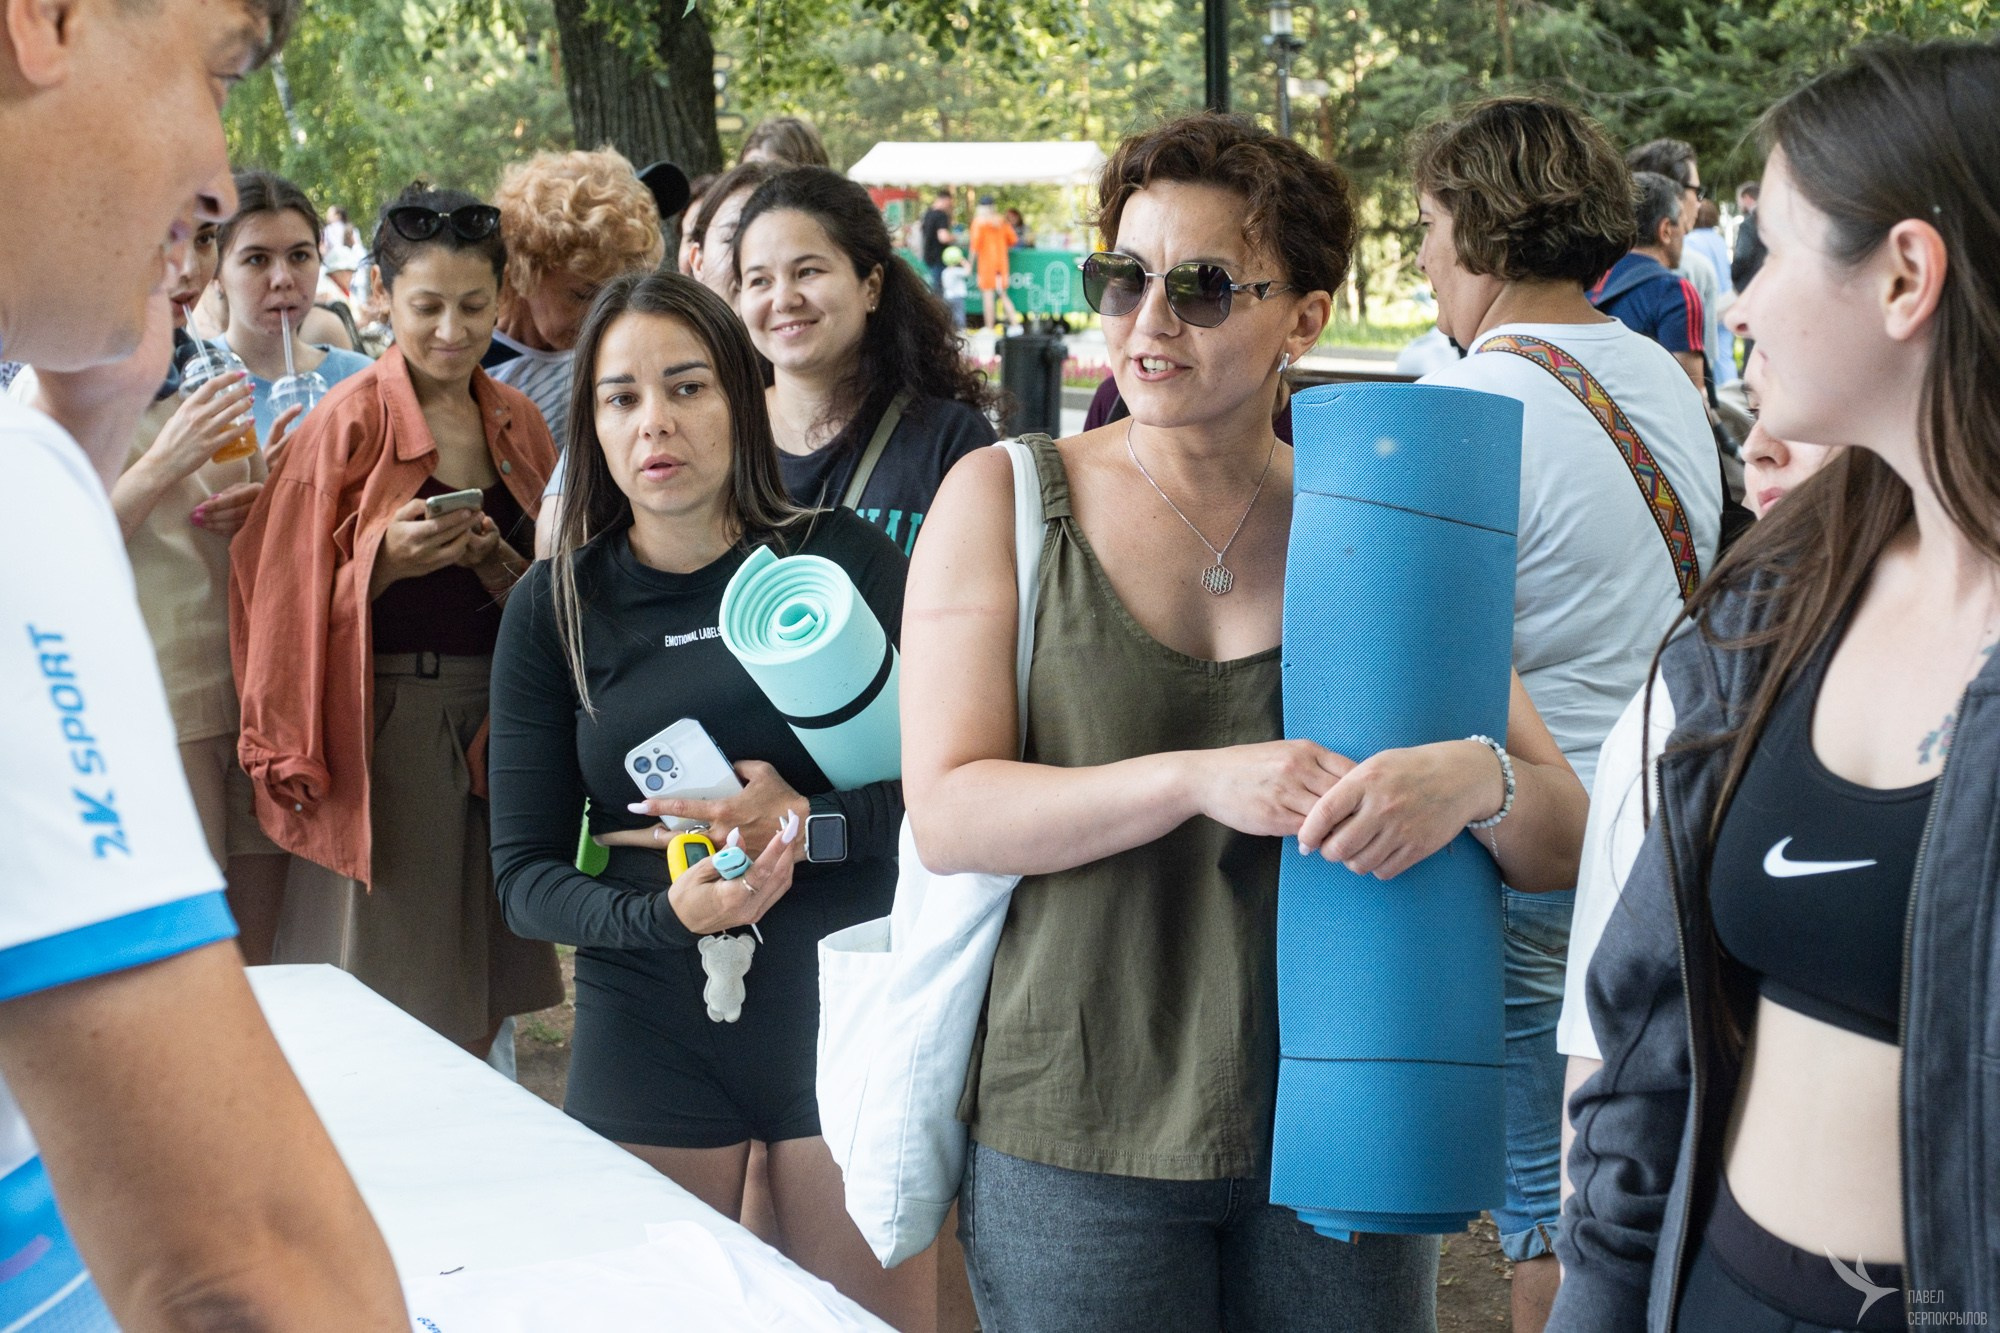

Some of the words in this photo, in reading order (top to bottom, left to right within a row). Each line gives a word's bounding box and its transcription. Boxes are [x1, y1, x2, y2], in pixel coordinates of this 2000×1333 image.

[664, 630, 699, 647] EMOTIONAL
[26, 623, 107, 775] SPORT
[72, 787, 131, 858] 2K
